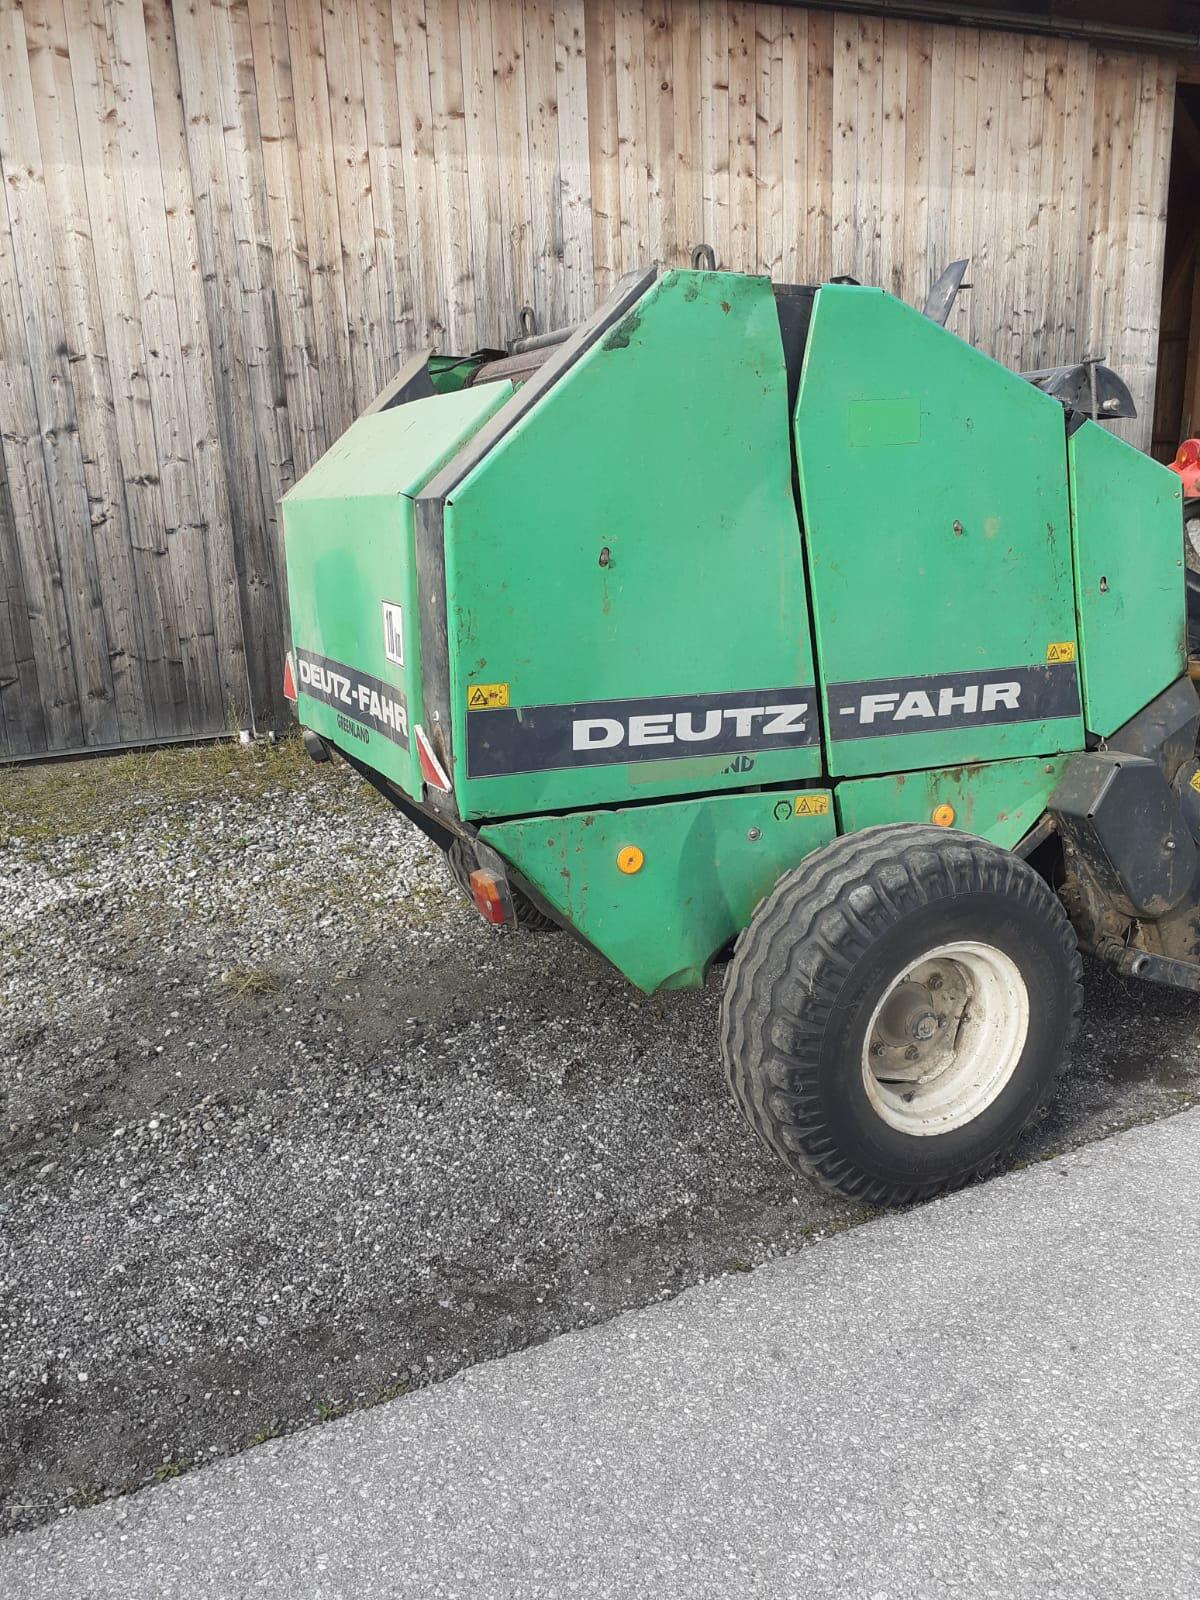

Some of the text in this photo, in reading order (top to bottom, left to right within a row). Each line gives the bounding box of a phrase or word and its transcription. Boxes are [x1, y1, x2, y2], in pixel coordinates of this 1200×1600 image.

[298, 659, 409, 737] DEUTZ-FAHR
[337, 713, 370, 745] GREENLAND
[572, 703, 808, 750] DEUTZ
